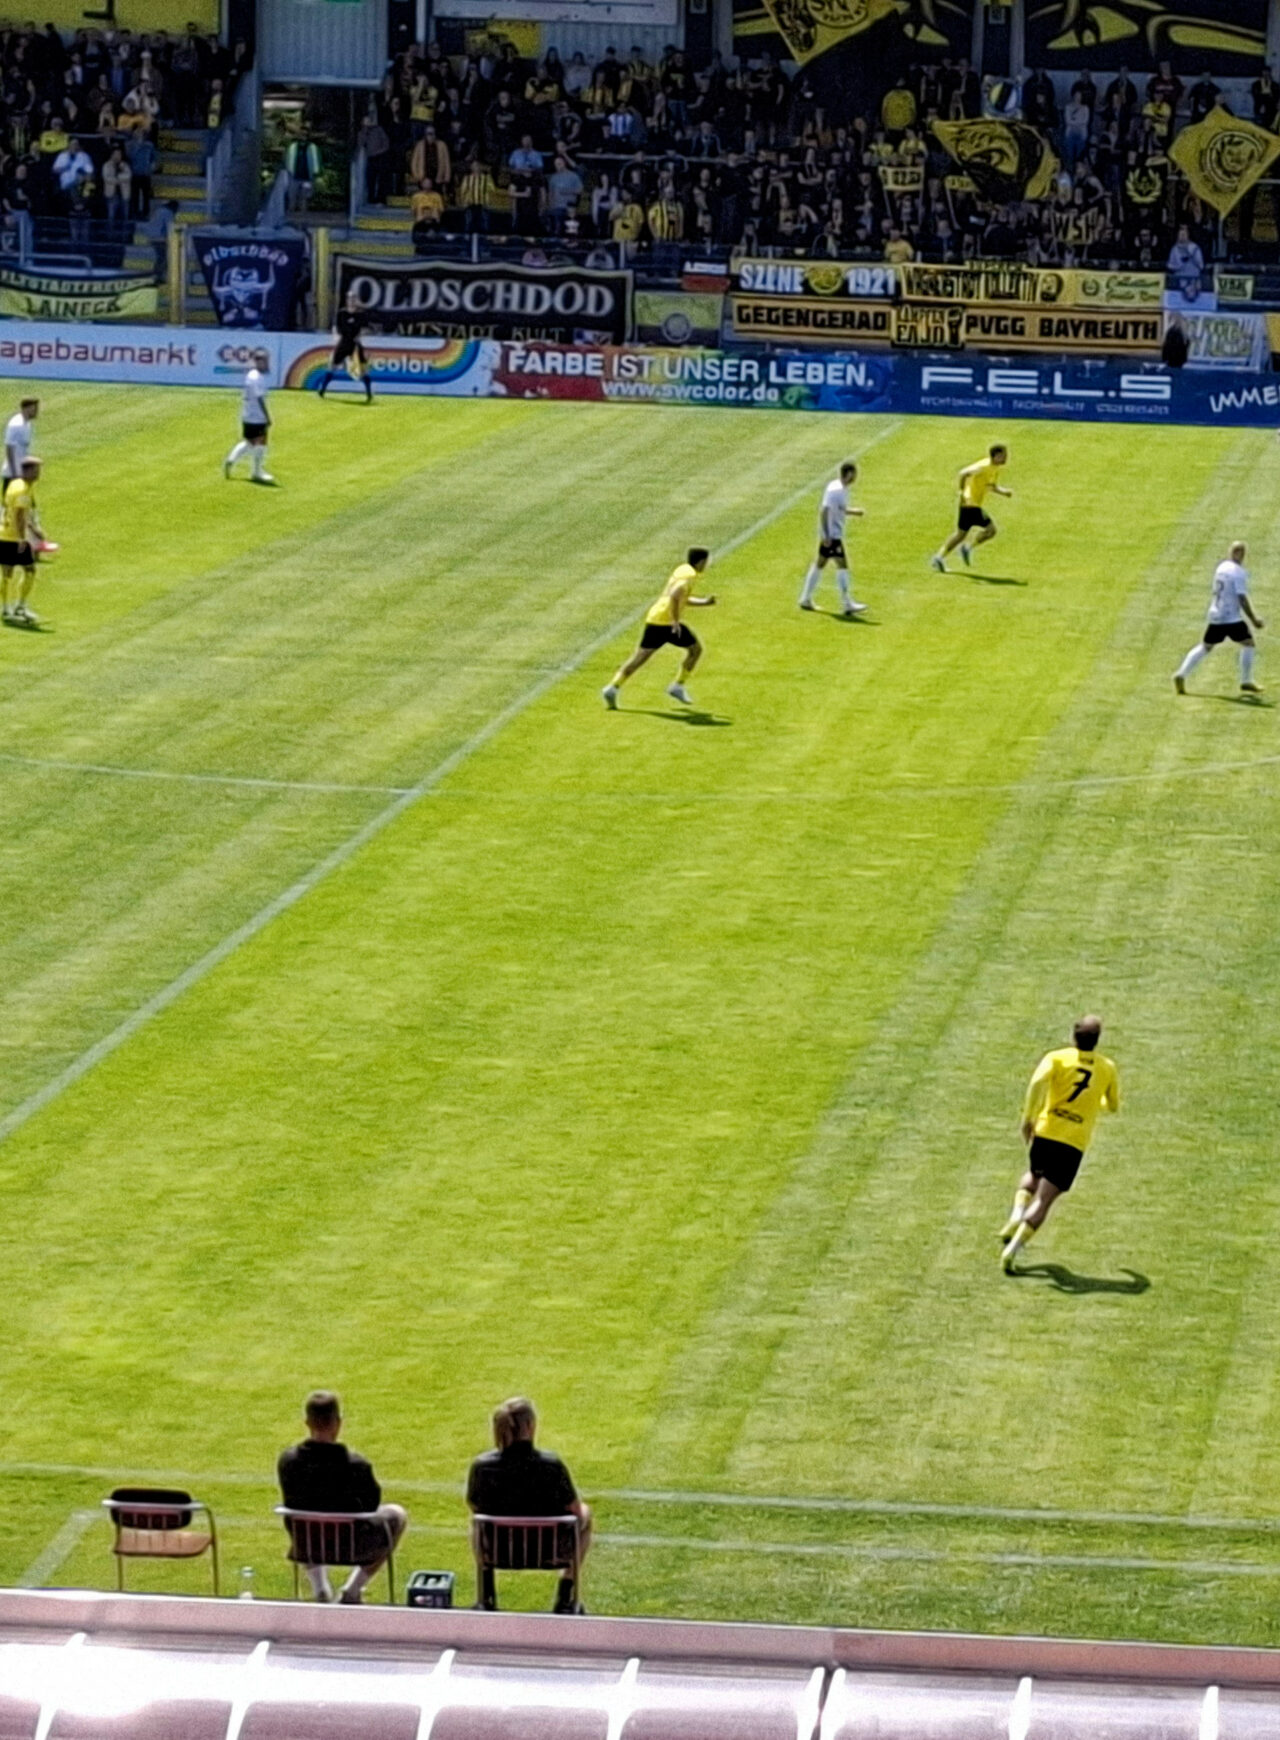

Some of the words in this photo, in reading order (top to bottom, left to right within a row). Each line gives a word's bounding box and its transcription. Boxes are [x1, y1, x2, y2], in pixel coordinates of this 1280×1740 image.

[740, 264, 804, 292] SZENE
[846, 267, 895, 295] 1921
[350, 275, 614, 317] OLDSCHDOD
[1039, 316, 1159, 340] BAYREUTH
[1, 338, 196, 366] agebaumarkt
[372, 355, 433, 373] color
[508, 350, 604, 376] FARBE
[613, 354, 652, 379] IST
[663, 357, 760, 382] UNSER
[768, 360, 875, 387] LEBEN.
[921, 366, 1172, 400] F.E.L.S
[602, 378, 778, 401] www.swcolor.de
[1067, 1068, 1092, 1102] 7
